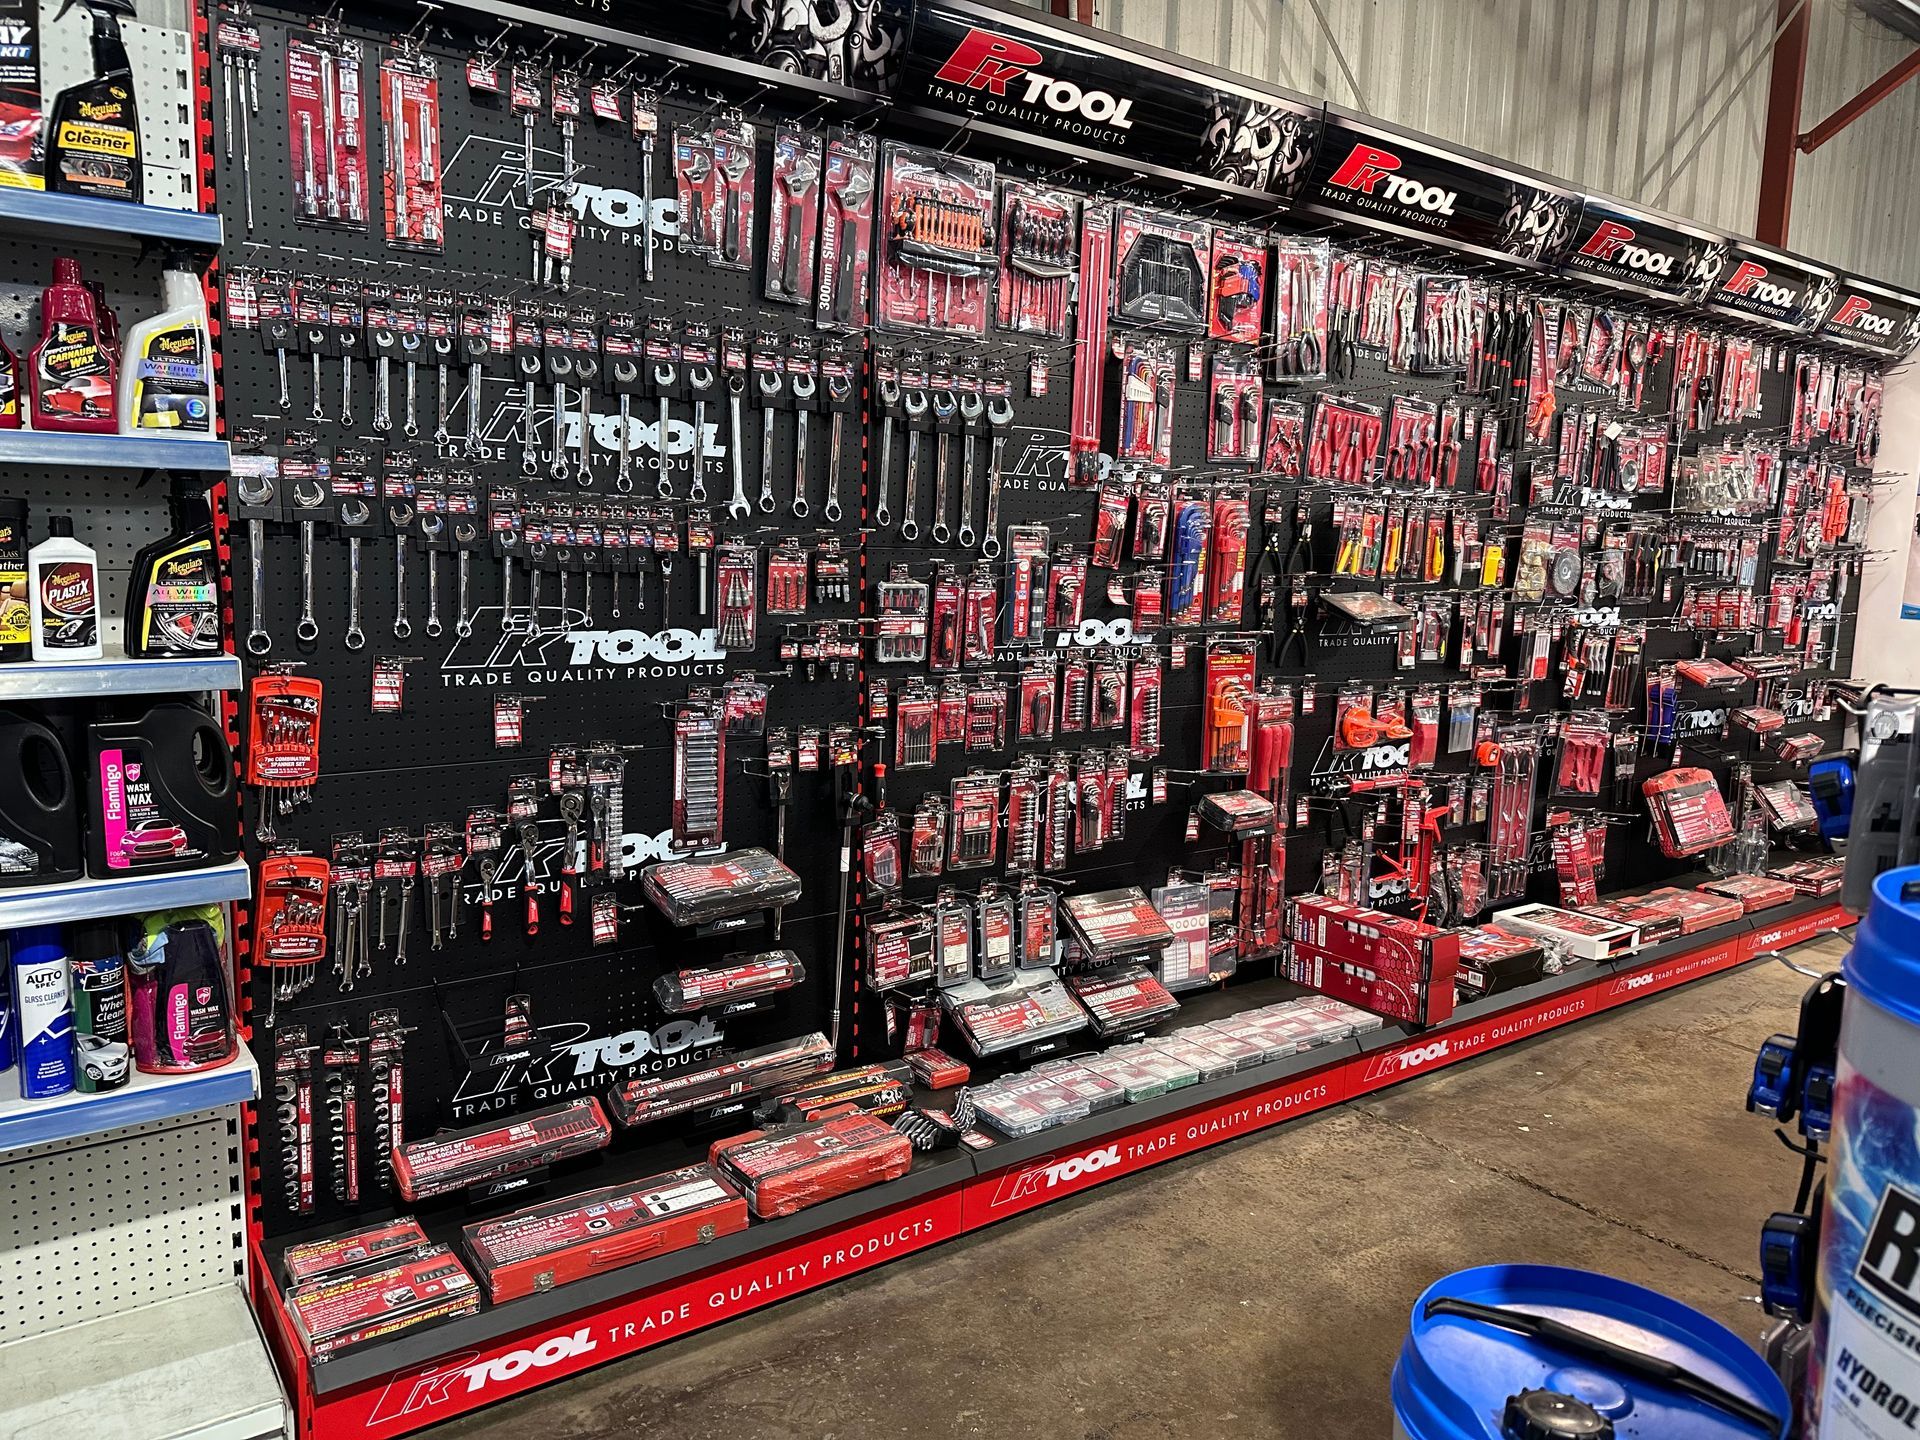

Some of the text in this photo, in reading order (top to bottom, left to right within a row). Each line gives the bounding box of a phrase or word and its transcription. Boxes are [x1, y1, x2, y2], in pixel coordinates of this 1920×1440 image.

[289, 58, 312, 69] Wobble
[289, 65, 319, 77] Extension
[289, 73, 313, 83] Bar Set
[78, 101, 122, 118] Meguiar's
[927, 84, 1127, 145] TRADE QUALITY PRODUCTS
[64, 130, 131, 150] Cleaner
[444, 200, 502, 226] RADE
[1320, 186, 1448, 229] TRADE QUALITY PRODUCTS
[819, 214, 836, 311] 300mm Shifter
[1570, 256, 1665, 287] TRADE QUALITY PRODUCTS
[1715, 292, 1786, 317] TRADE QUALITY PRODUCTS
[1825, 323, 1886, 344] TRADE QUALITY PRODUCTS
[48, 344, 98, 366] CARNAUBA
[159, 336, 196, 354] Meguiar's
[70, 354, 95, 370] WAX
[151, 356, 196, 365] ULTIMATE
[1577, 383, 1609, 396] QUALITY
[167, 558, 203, 575] Meguiar's
[1319, 636, 1390, 647] TRADE QUALITY
[441, 663, 725, 687] TRADE QUALITY PRODUCTS
[107, 764, 122, 820] Flamingo
[126, 783, 150, 793] WASH
[127, 793, 152, 806] WAX
[1783, 929, 1797, 939] TRADE
[1798, 920, 1817, 934] QUALITY
[1817, 913, 1840, 926] PRODUCTS
[1655, 969, 1673, 981] TRADE
[1675, 961, 1699, 975] QUALITY
[1700, 951, 1729, 966] PRODUCTS
[26, 970, 62, 985] AUTO
[35, 981, 56, 989] SPEC
[101, 970, 122, 984] SPP
[24, 990, 66, 1004] GLASS CLEANER
[174, 993, 187, 1040] Flamingo
[190, 1005, 219, 1016] WASH WAX
[1453, 1032, 1486, 1052] TRADE
[1491, 1015, 1534, 1040] QUALITY
[1537, 999, 1586, 1024] PRODUCTS
[453, 1046, 724, 1118] TRADE QUALITY PRODUCTS
[630, 1069, 720, 1099] 1/2" DR TORQUE WRENCH
[870, 1103, 904, 1117] WRENCH
[1127, 1133, 1176, 1160] TRADE
[1186, 1109, 1249, 1141] QUALITY
[1256, 1084, 1327, 1117] PRODUCTS
[408, 1152, 426, 1161] DEEP
[426, 1146, 453, 1157] IMPACT
[410, 1144, 476, 1166] SWIVEL SOCKET SET
[483, 1220, 565, 1247] Impact Socket Set
[522, 1220, 547, 1232] Short
[609, 1305, 690, 1344] TRADE
[708, 1261, 811, 1309] QUALITY
[822, 1217, 935, 1267] PRODUCTS
